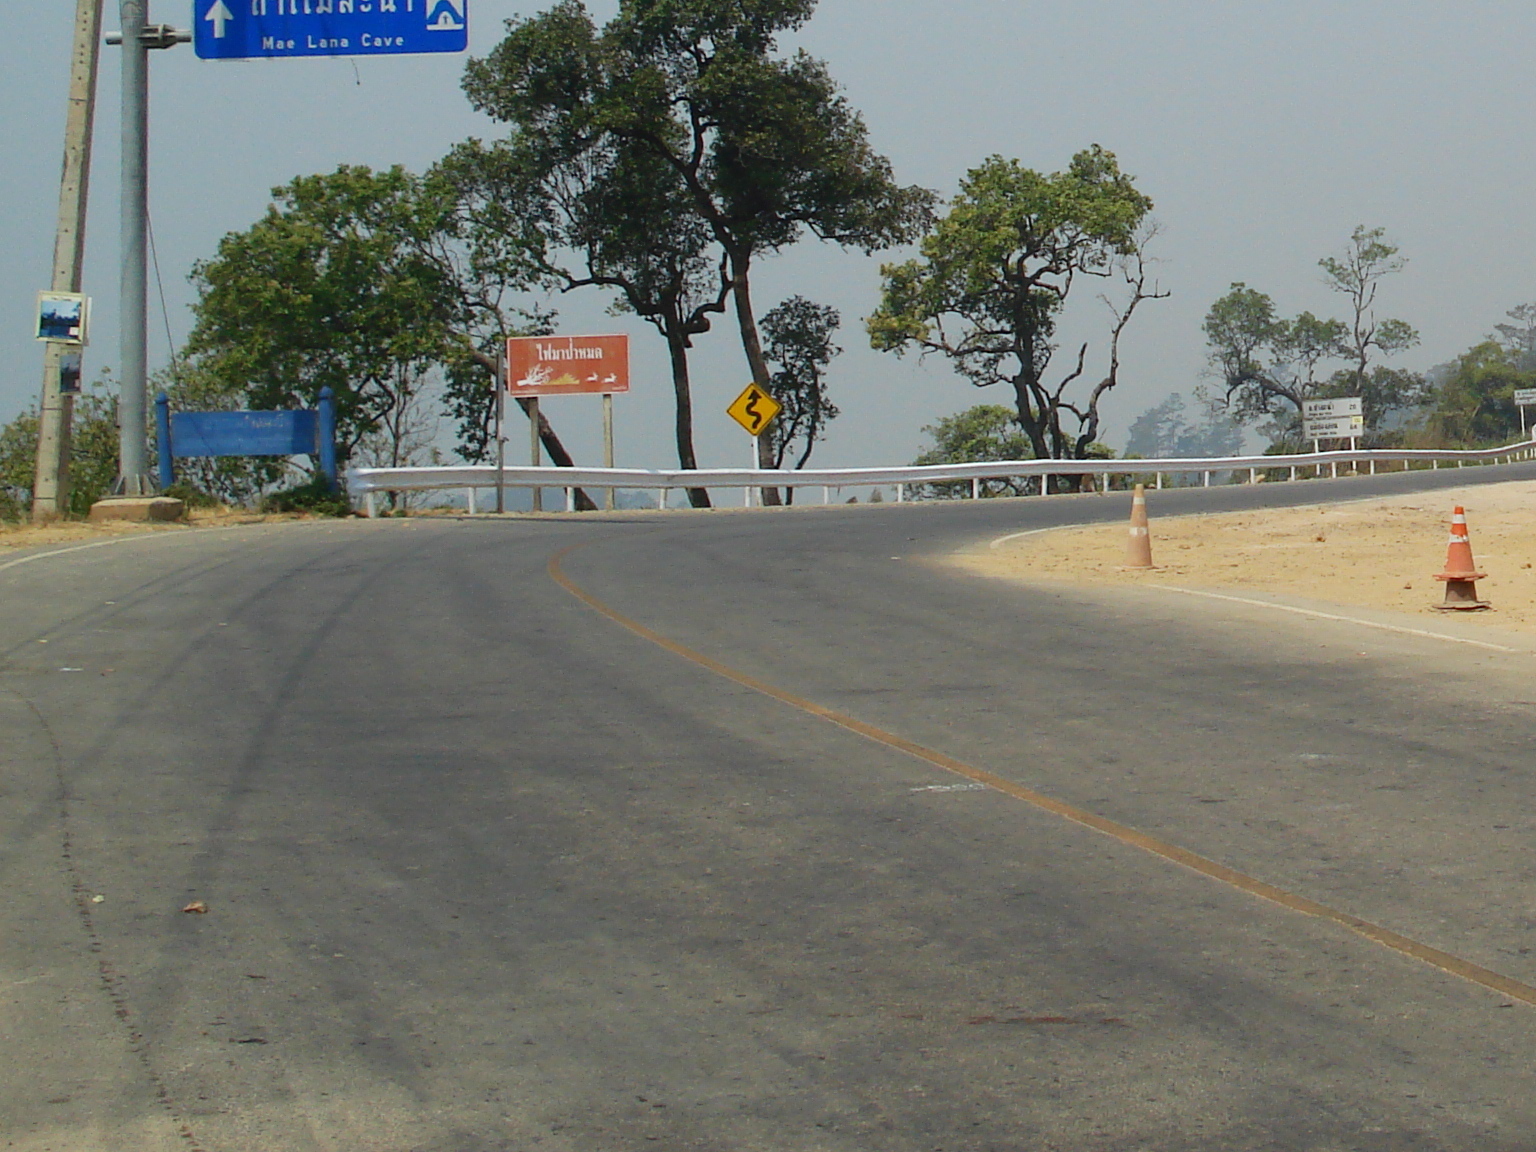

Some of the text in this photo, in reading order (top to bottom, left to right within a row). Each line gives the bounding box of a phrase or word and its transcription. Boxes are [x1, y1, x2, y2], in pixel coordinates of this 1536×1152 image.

[263, 34, 404, 50] Mae Lana Cave
